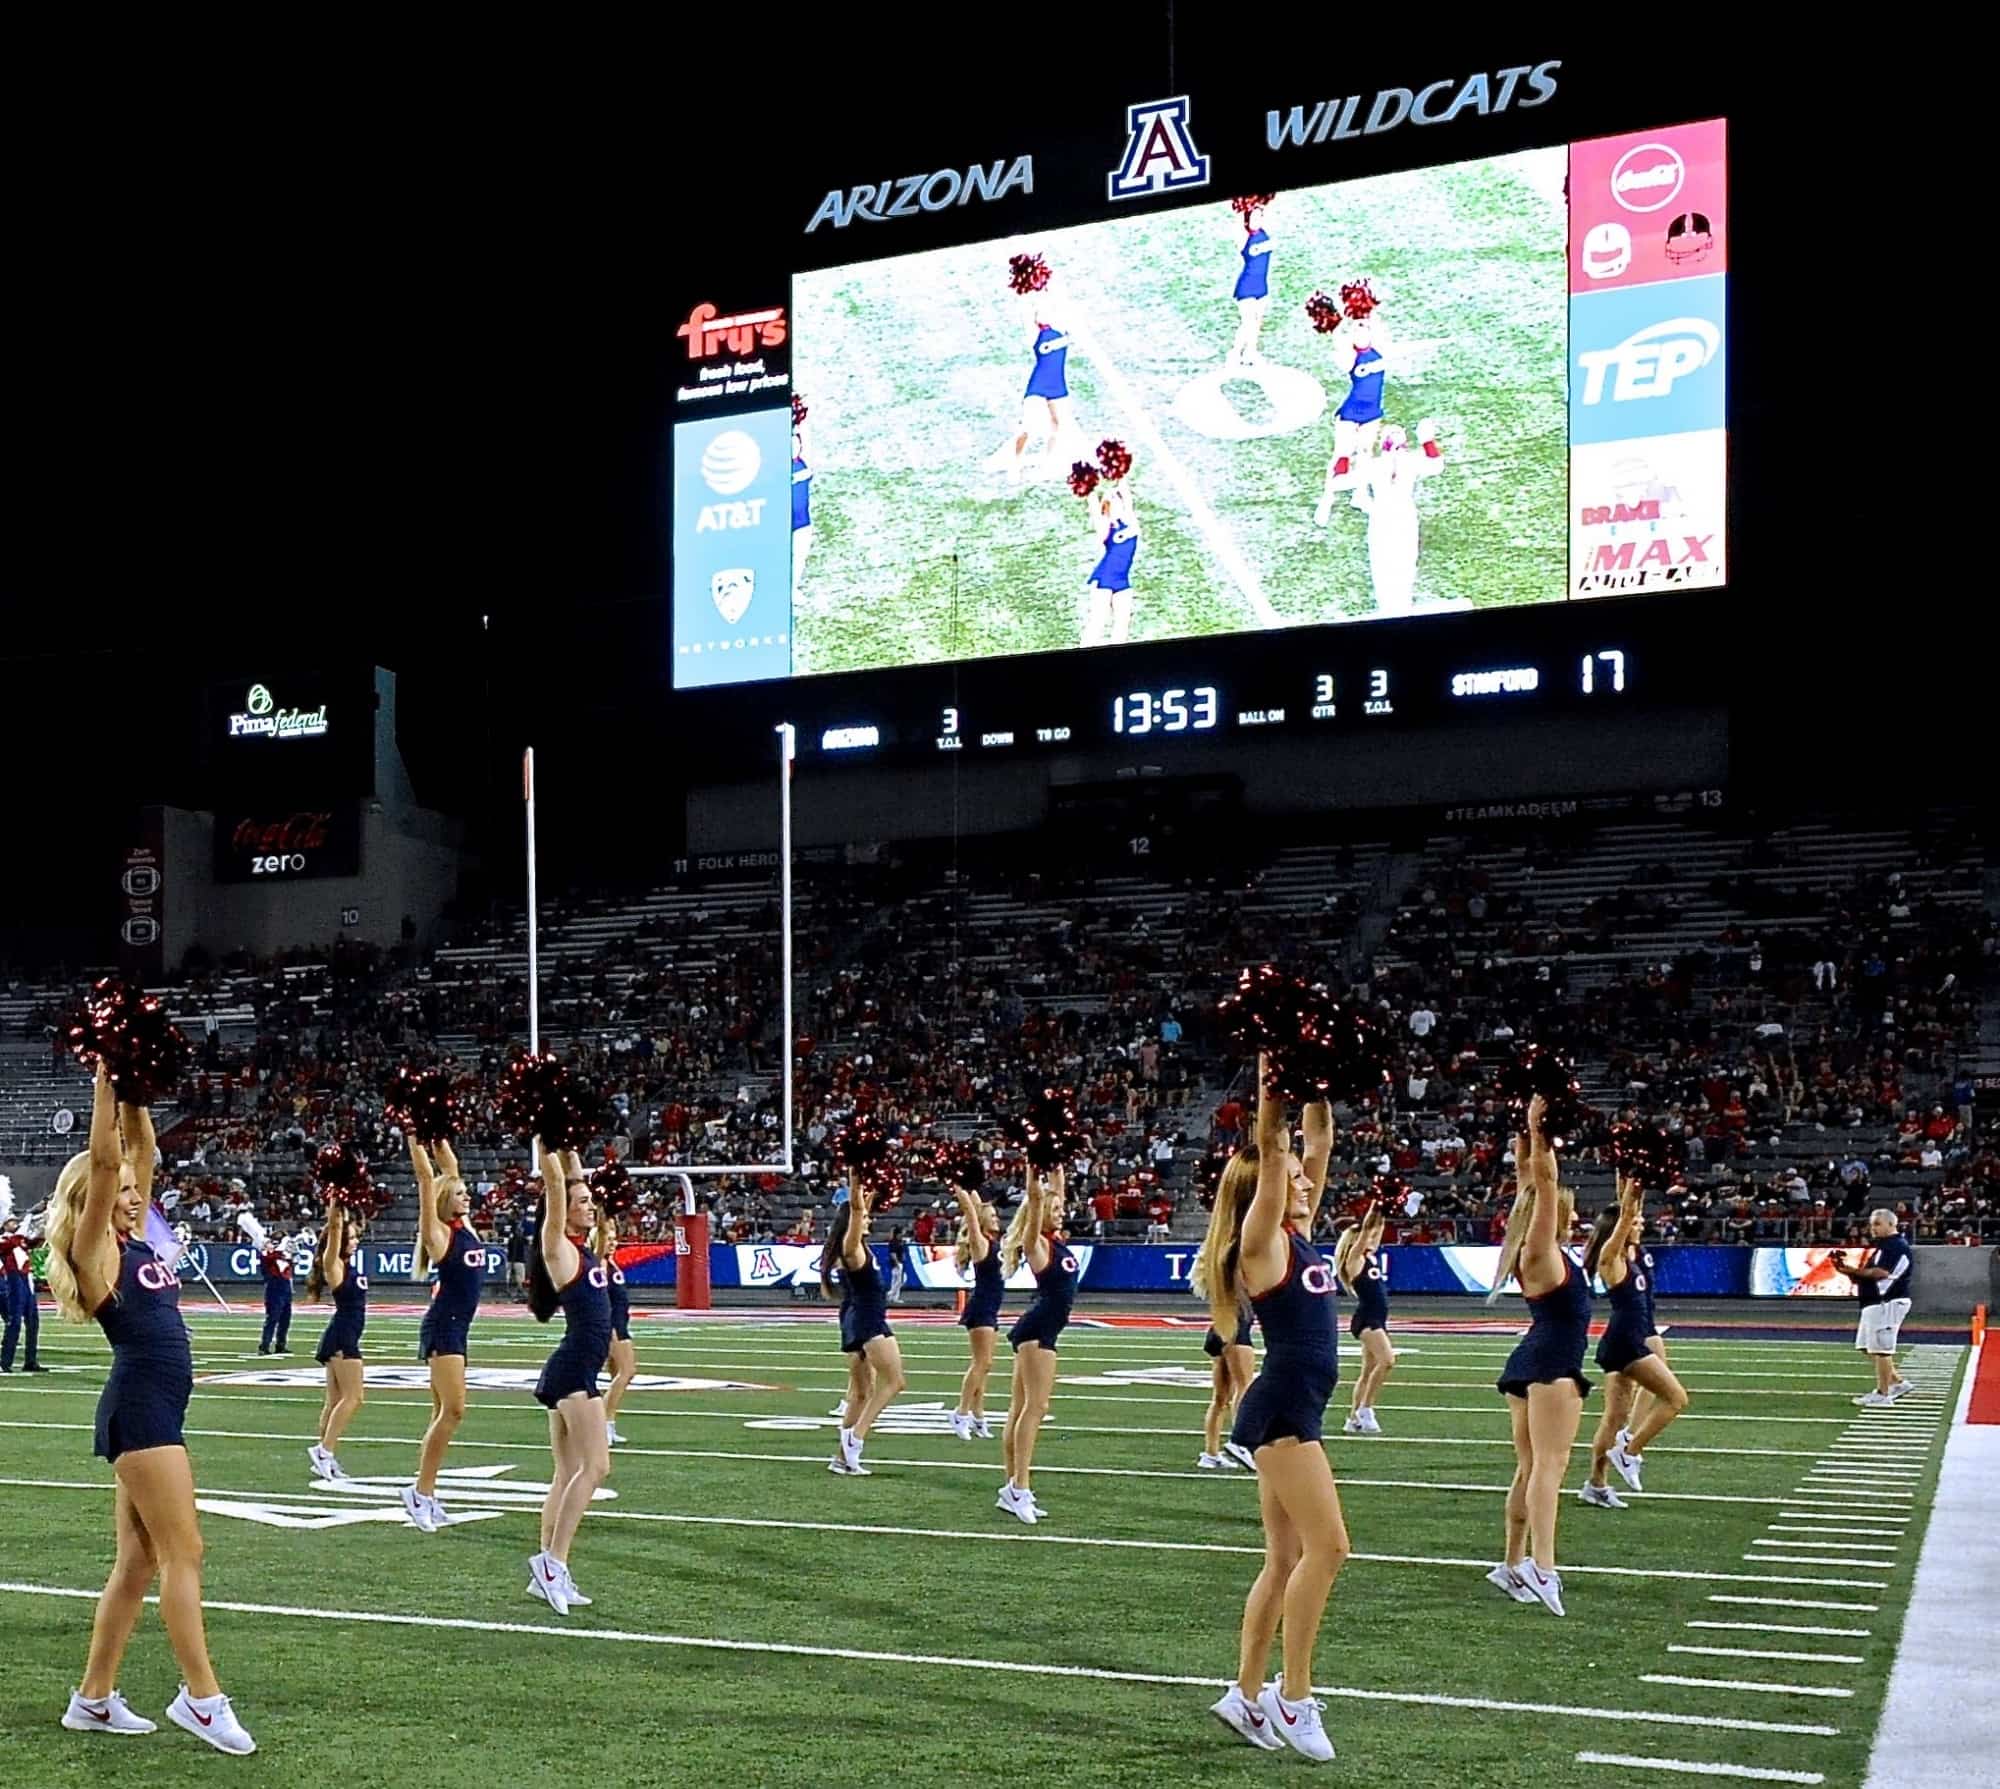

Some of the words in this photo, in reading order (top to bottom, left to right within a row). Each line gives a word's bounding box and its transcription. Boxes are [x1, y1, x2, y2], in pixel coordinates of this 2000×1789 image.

[1264, 59, 1562, 151] WILDCATS
[804, 154, 1035, 234] ARIZONA
[677, 303, 786, 358] fry's
[1577, 318, 1721, 406] TEP
[695, 498, 767, 533] AT&T
[1592, 534, 1715, 572] MAX
[1371, 670, 1389, 697] 3
[1582, 650, 1625, 693] 17
[1316, 674, 1334, 702] 3
[943, 708, 959, 733] 3
[1113, 687, 1218, 734] 13:53
[1238, 710, 1267, 724] BALL
[982, 733, 1014, 746] DOWN
[1054, 727, 1071, 741] GO
[1445, 801, 1577, 822] #TEAMKADEEM
[1700, 790, 1722, 807] 13
[1128, 835, 1152, 856] 12
[250, 853, 306, 875] zero
[673, 859, 687, 873] 11
[698, 856, 736, 871] FOLK
[738, 852, 779, 868] HERO
[342, 909, 360, 927] 10
